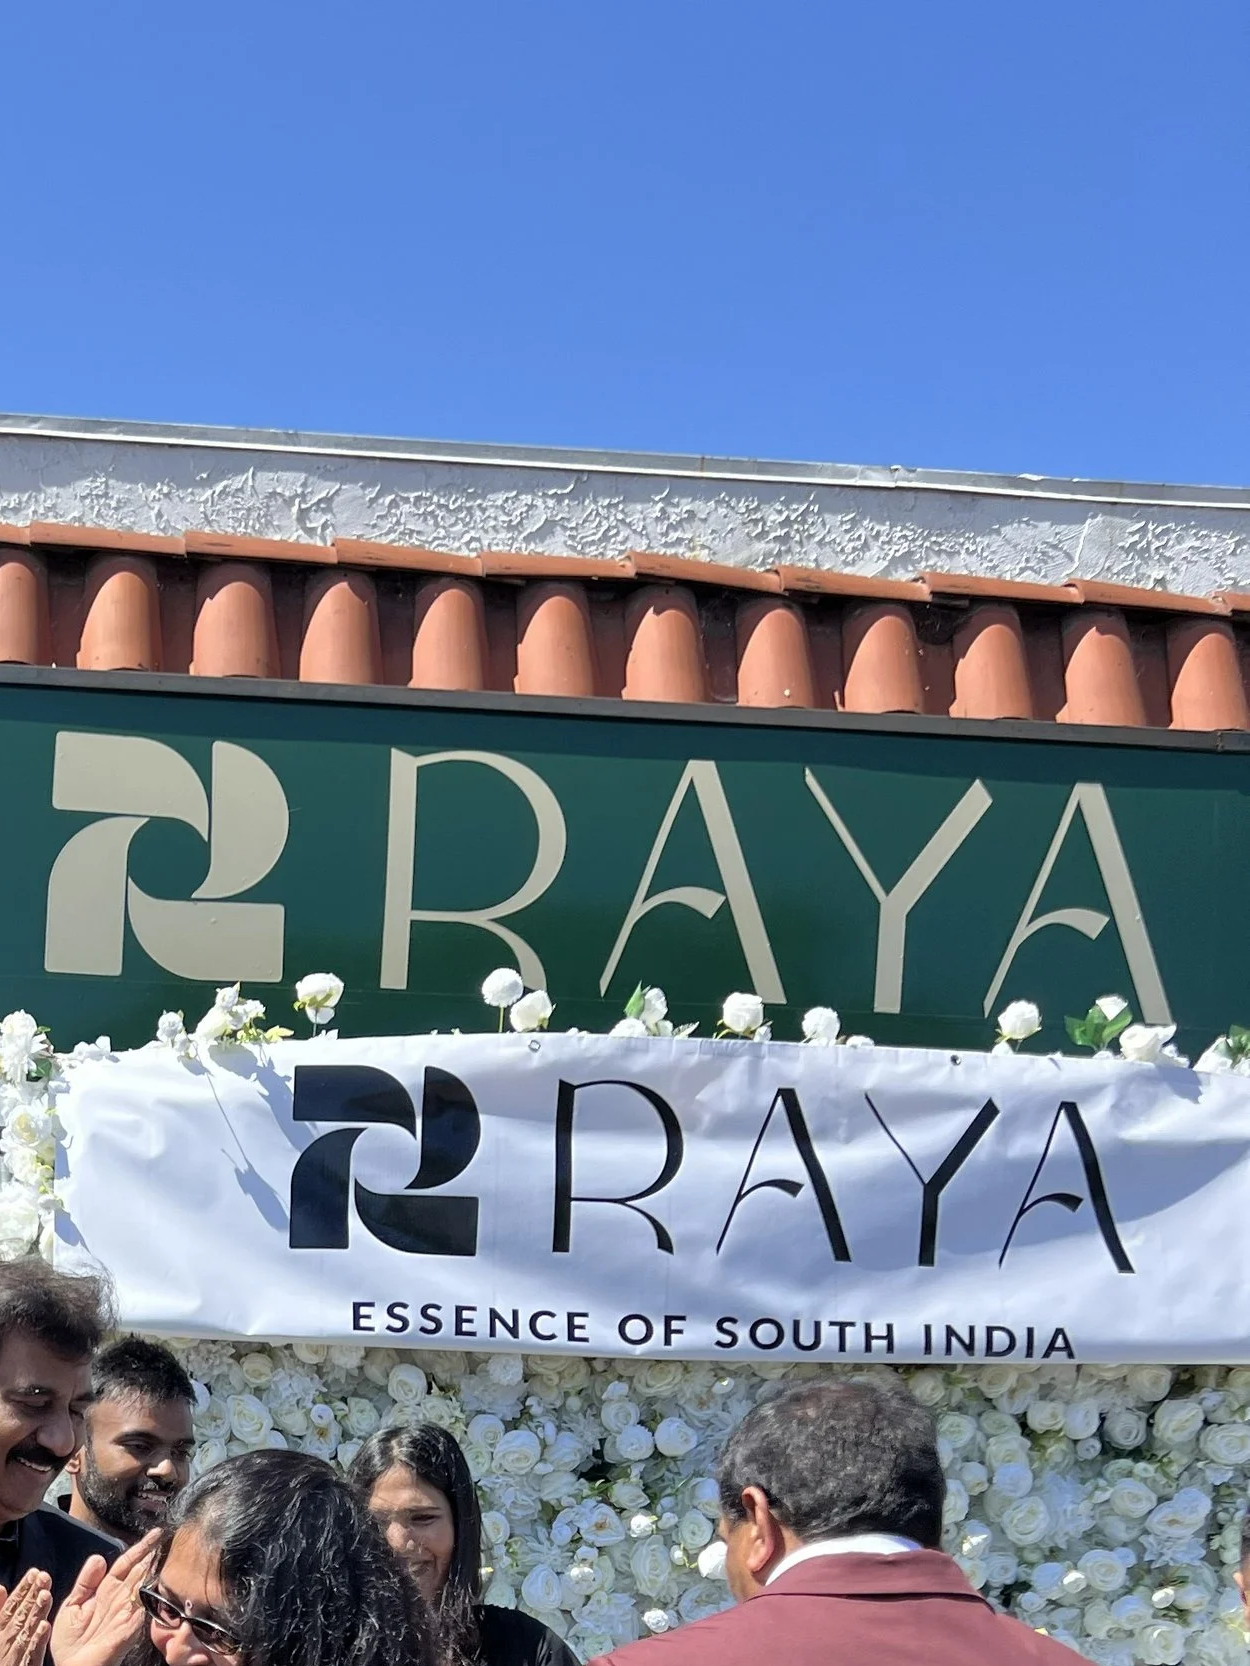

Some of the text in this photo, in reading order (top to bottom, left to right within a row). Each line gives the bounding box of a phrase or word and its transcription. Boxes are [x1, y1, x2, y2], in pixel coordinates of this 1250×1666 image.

[380, 746, 1173, 1025] RAYA
[551, 1077, 1136, 1274] RAYA
[351, 1300, 1077, 1361] ESSENCE OF SOUTH INDIA
